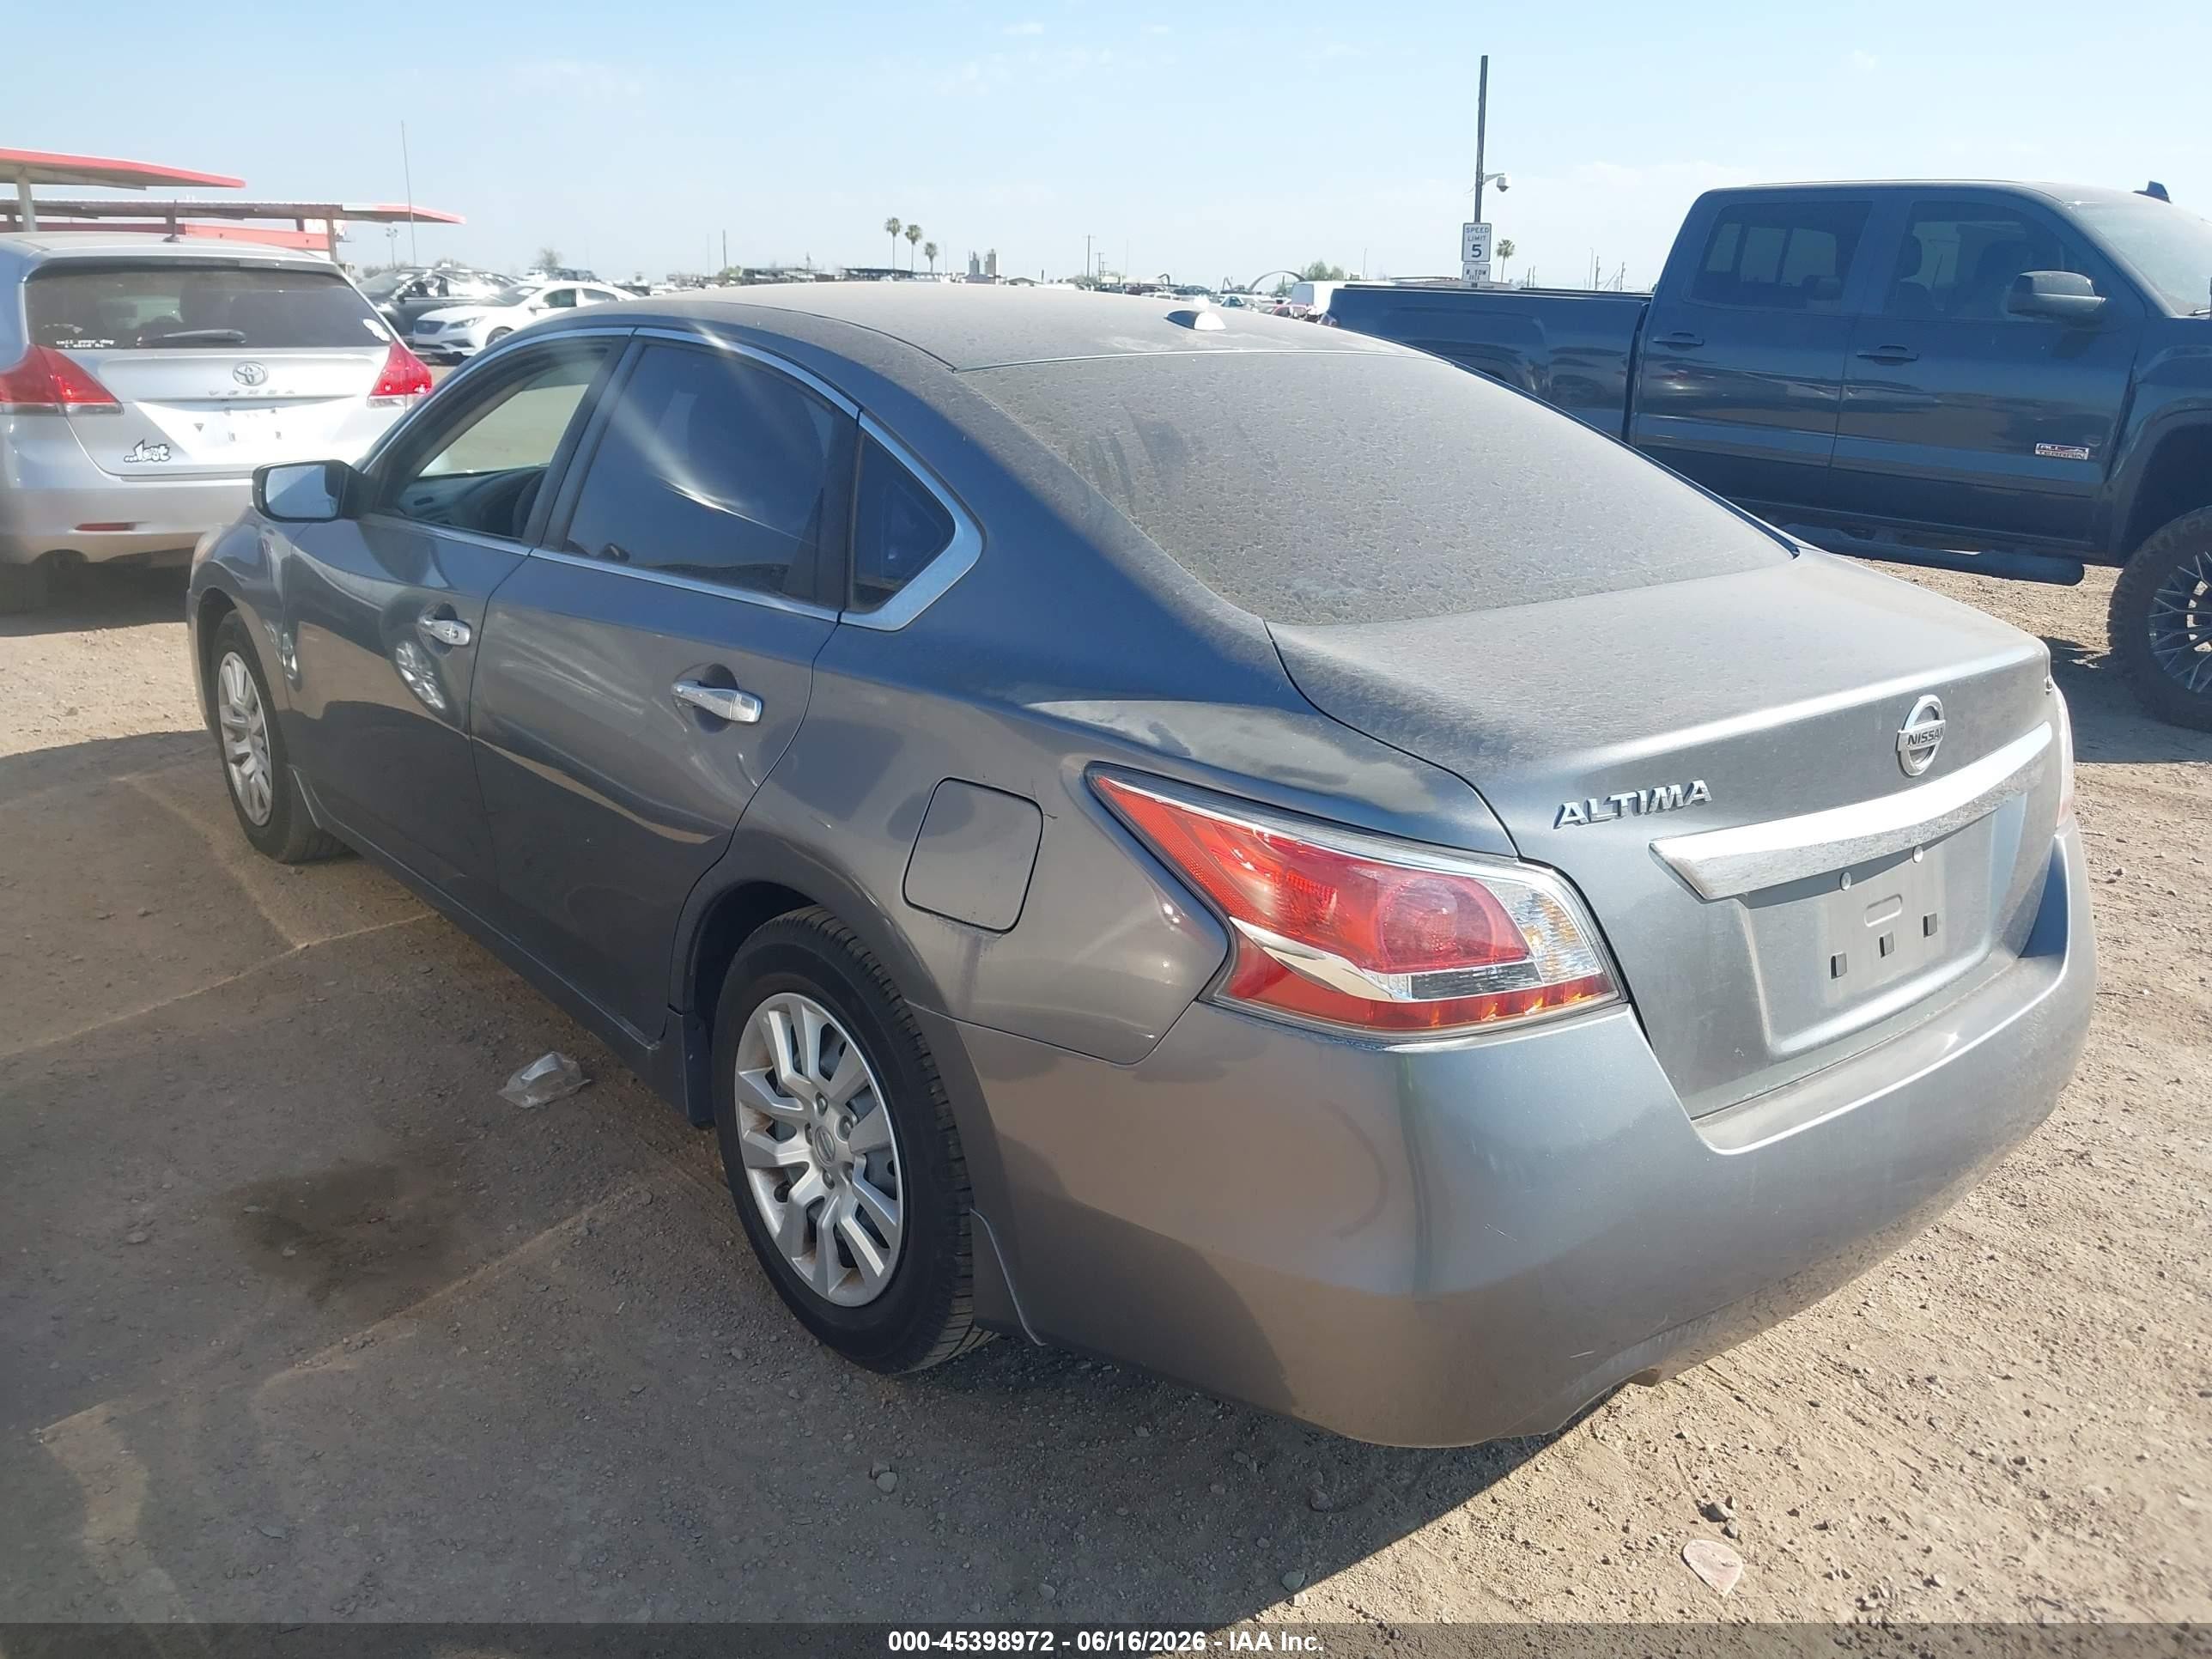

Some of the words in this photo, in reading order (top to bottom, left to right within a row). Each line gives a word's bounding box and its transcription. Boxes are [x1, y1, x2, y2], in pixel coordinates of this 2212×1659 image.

[1471, 244, 1482, 258] 5
[1907, 727, 1944, 745] NISSAN
[1553, 779, 1713, 830] ALTIMA
